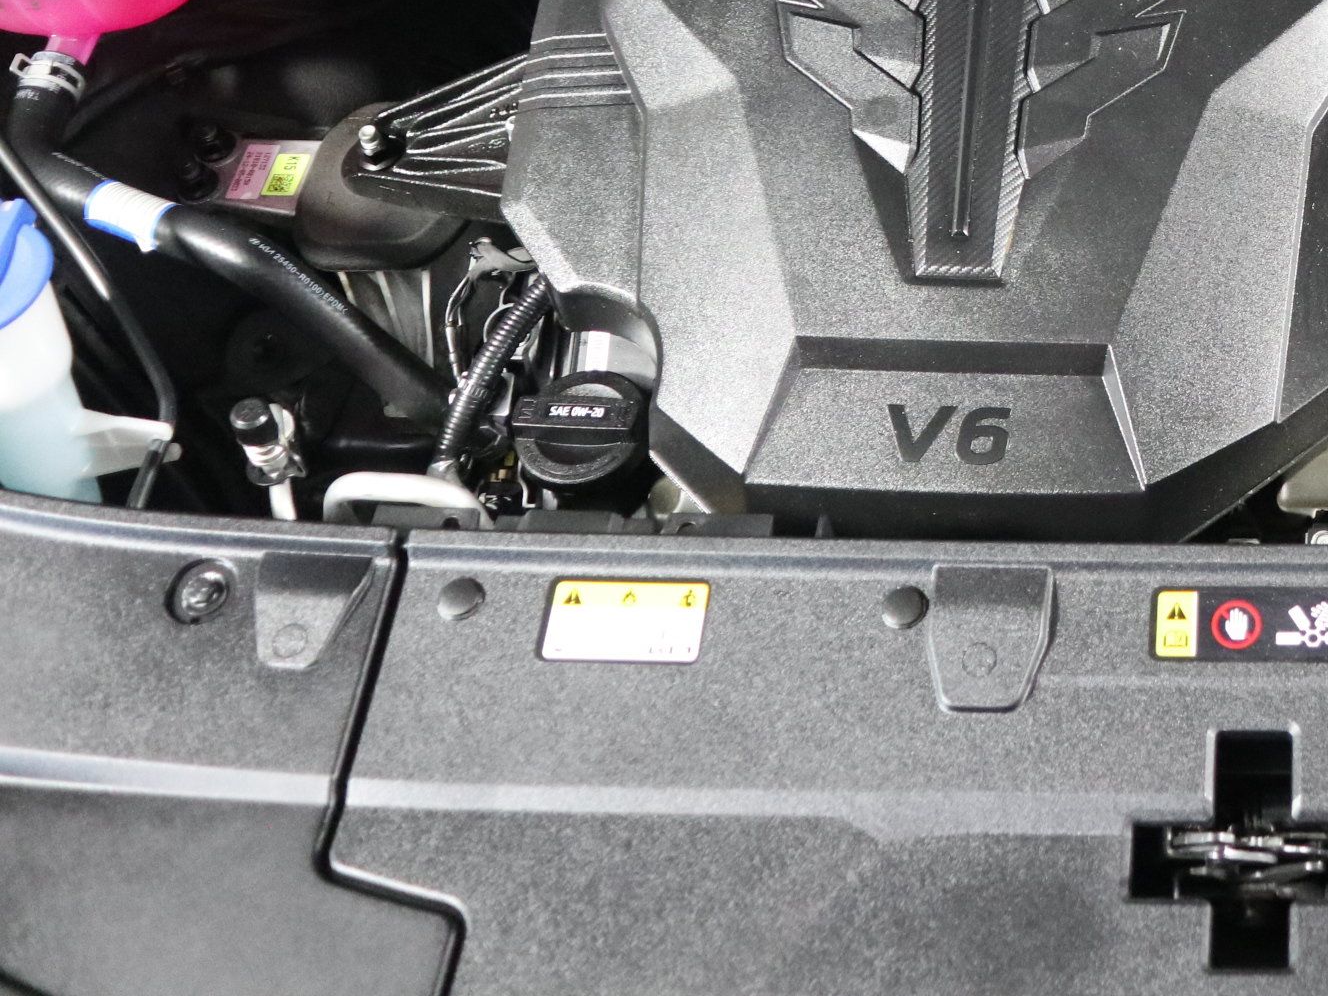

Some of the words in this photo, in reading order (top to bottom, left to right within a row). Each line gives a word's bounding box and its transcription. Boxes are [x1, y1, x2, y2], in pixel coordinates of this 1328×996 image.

[549, 406, 570, 416] SAE
[571, 406, 605, 418] 0W-20
[887, 404, 1012, 466] V6
